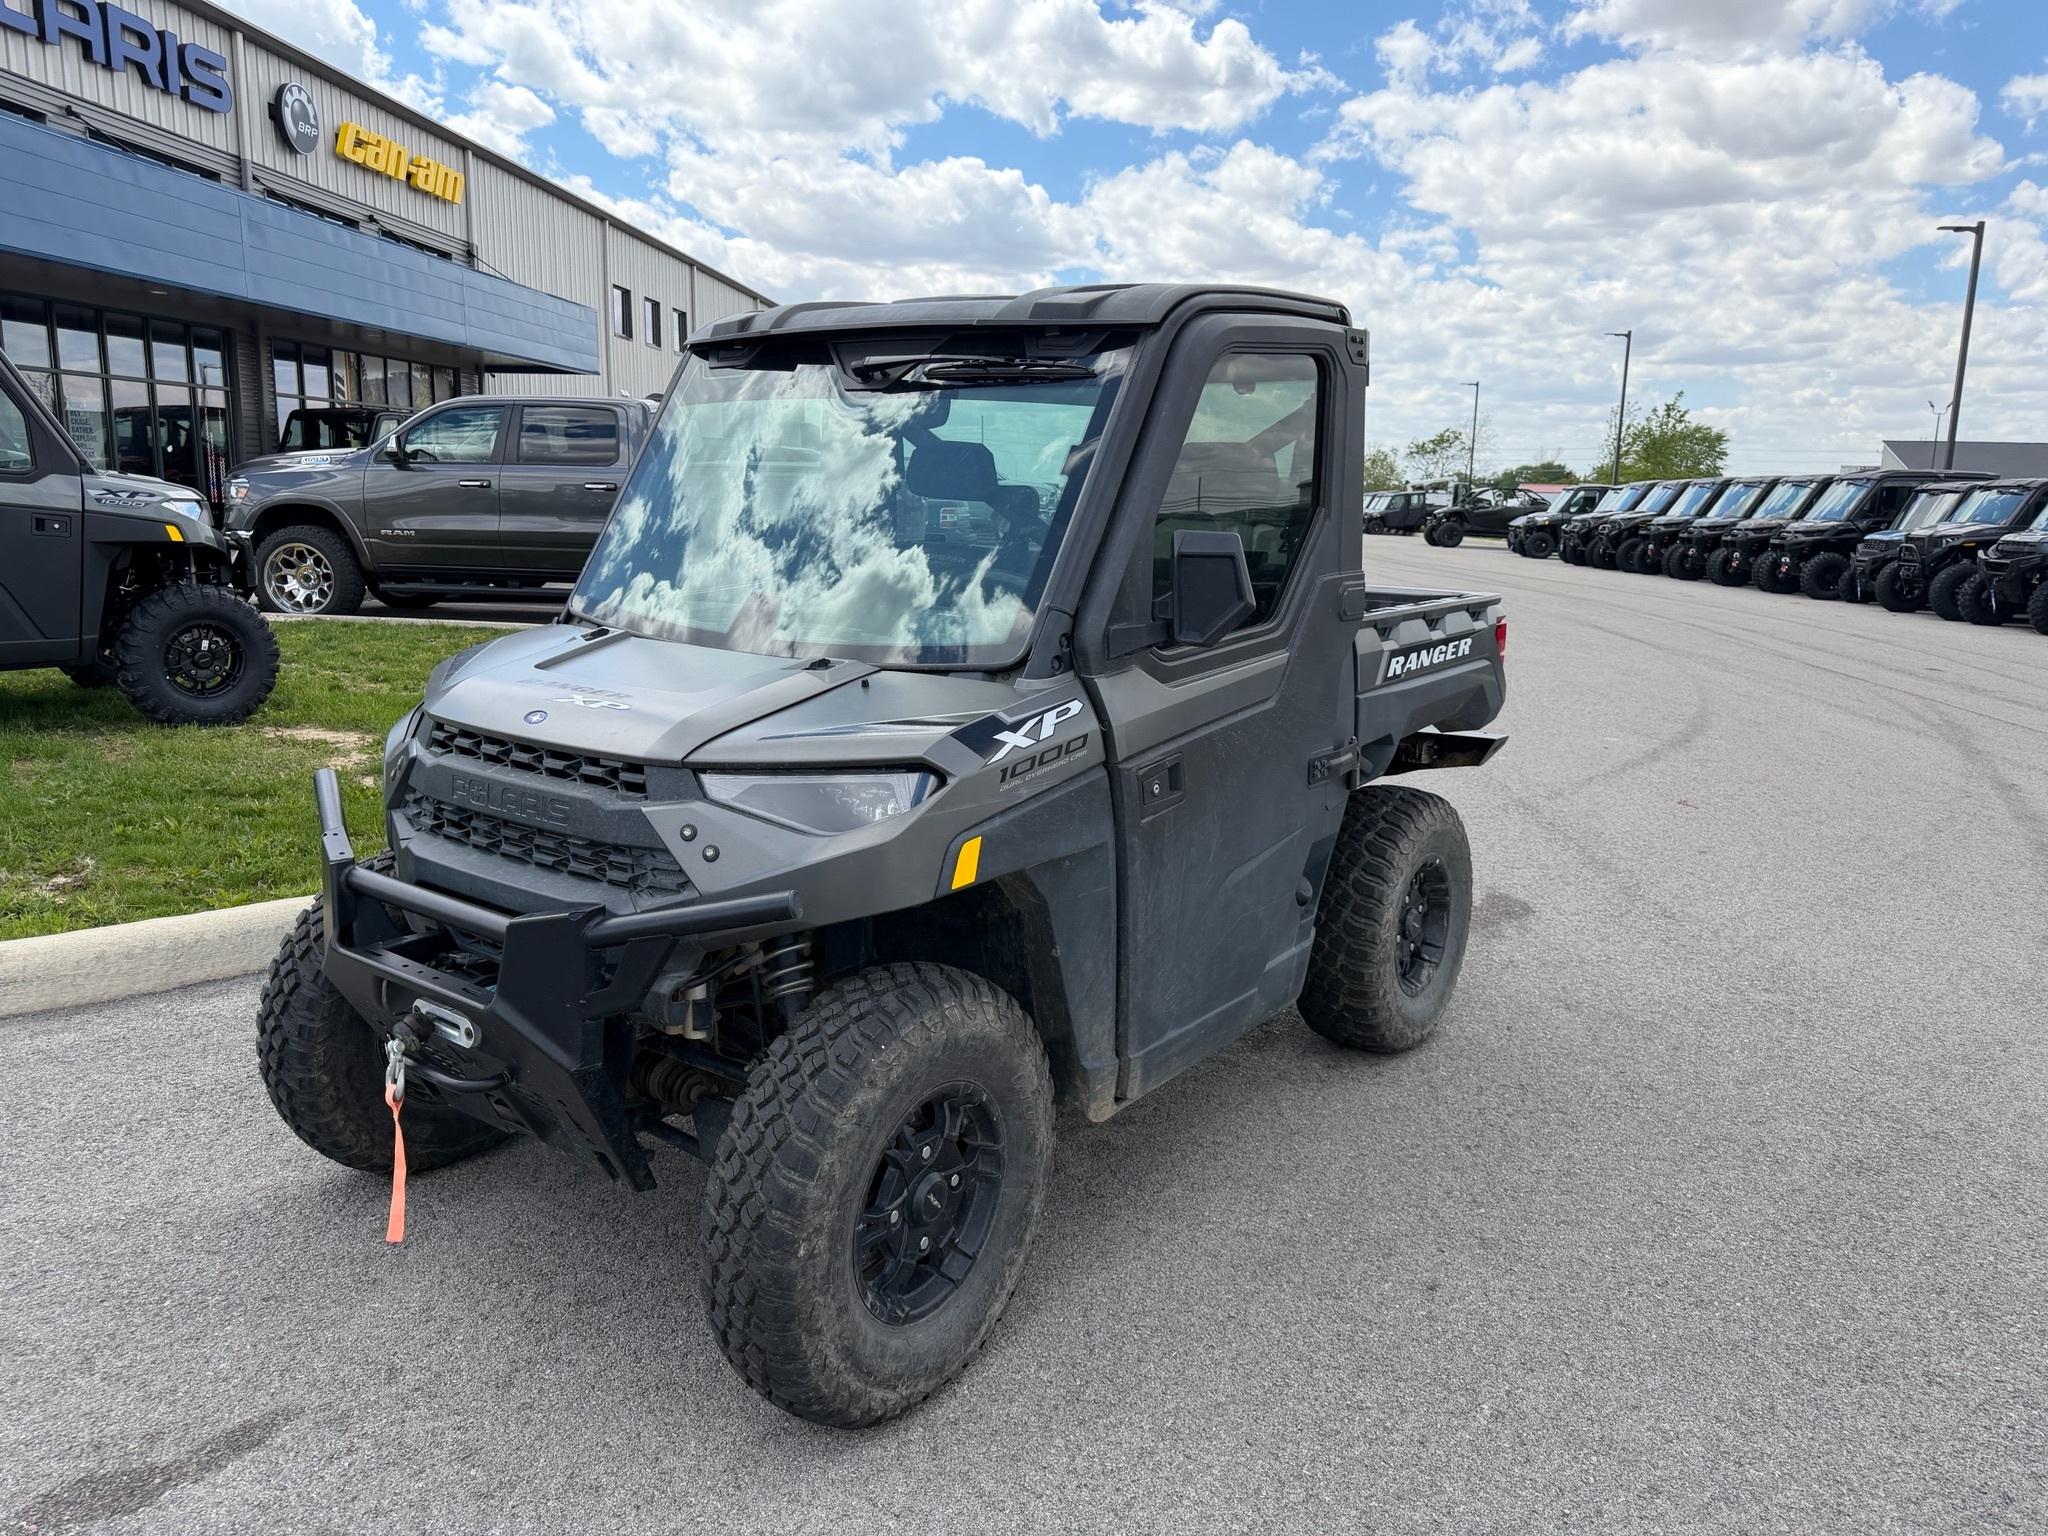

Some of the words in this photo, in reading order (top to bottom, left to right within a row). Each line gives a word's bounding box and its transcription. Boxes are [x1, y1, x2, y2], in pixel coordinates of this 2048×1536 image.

[297, 121, 318, 138] BRP
[96, 488, 157, 499] XP
[100, 499, 146, 508] 1000
[380, 529, 416, 537] RAM
[1387, 638, 1473, 678] RANGER
[548, 694, 631, 710] XP
[983, 699, 1083, 767] XP
[1000, 733, 1088, 784] 1000
[1000, 780, 1024, 792] DUAL
[1025, 758, 1070, 781] OVERHEAD
[1070, 749, 1088, 761] CAM
[453, 774, 570, 827] POLARIS
[926, 1192, 942, 1209] XP
